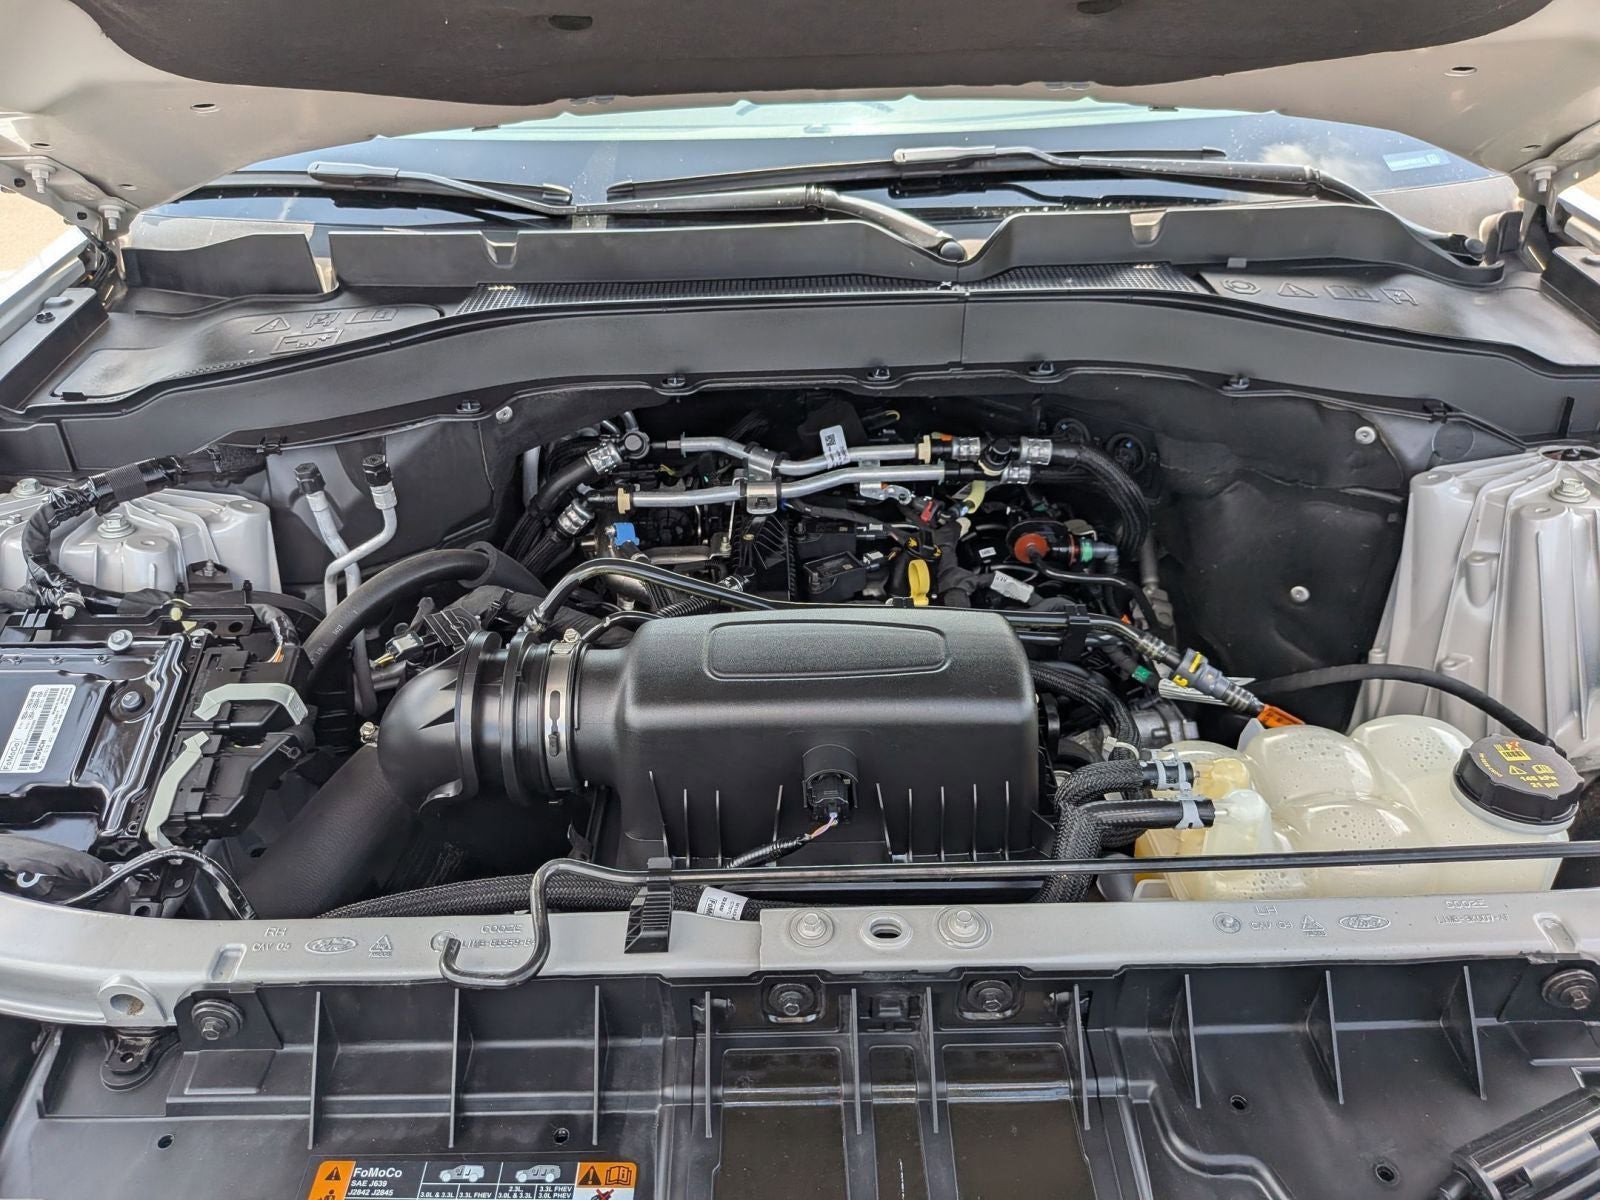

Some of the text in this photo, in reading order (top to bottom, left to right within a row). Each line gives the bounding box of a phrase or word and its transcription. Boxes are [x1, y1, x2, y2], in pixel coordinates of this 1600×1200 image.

[4, 743, 20, 770] FoMoCo
[33, 739, 47, 760] BOSCH
[1255, 904, 1278, 916] LH
[353, 1167, 402, 1178] FoMoCo
